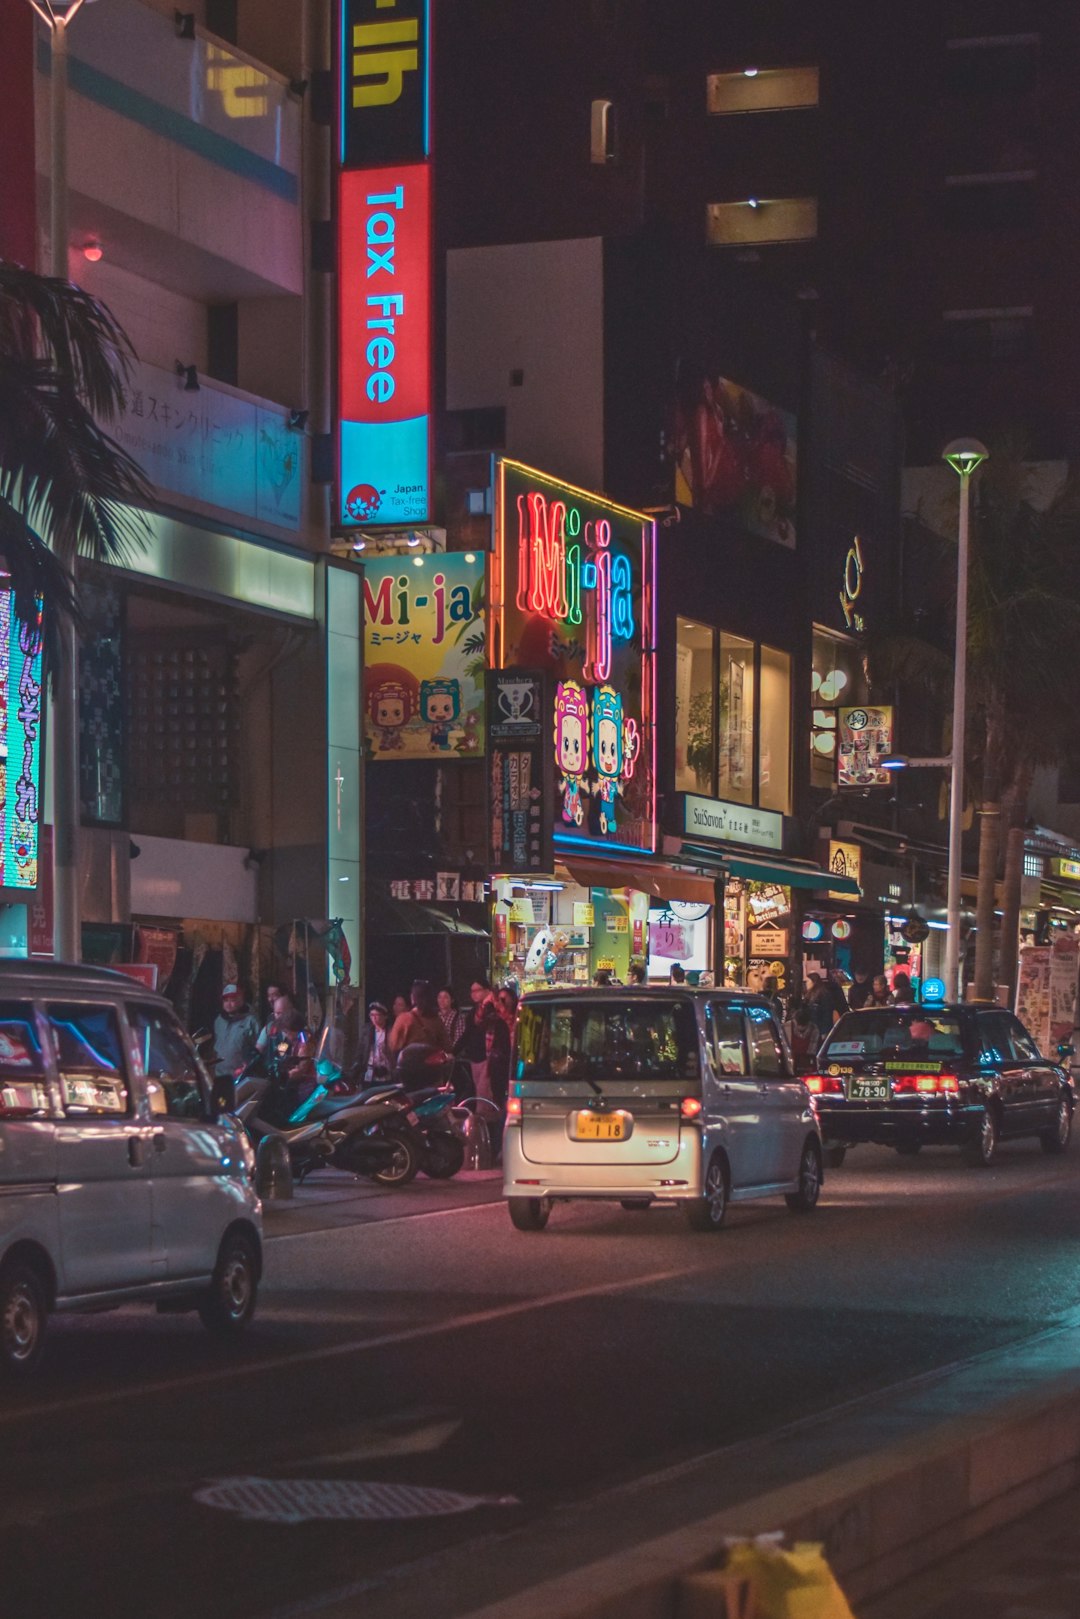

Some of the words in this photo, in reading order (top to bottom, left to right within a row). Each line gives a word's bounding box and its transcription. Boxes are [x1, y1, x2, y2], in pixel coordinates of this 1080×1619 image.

[367, 185, 404, 278] Tax
[367, 294, 404, 403] Free
[403, 507, 427, 517] Shop
[517, 492, 634, 682] Mi-ja
[364, 575, 473, 644] Mi-ja
[371, 631, 421, 645] ミージャ
[693, 808, 723, 829] SuiSavon
[656, 911, 675, 947] 香り
[858, 1086, 886, 1097] 78-90
